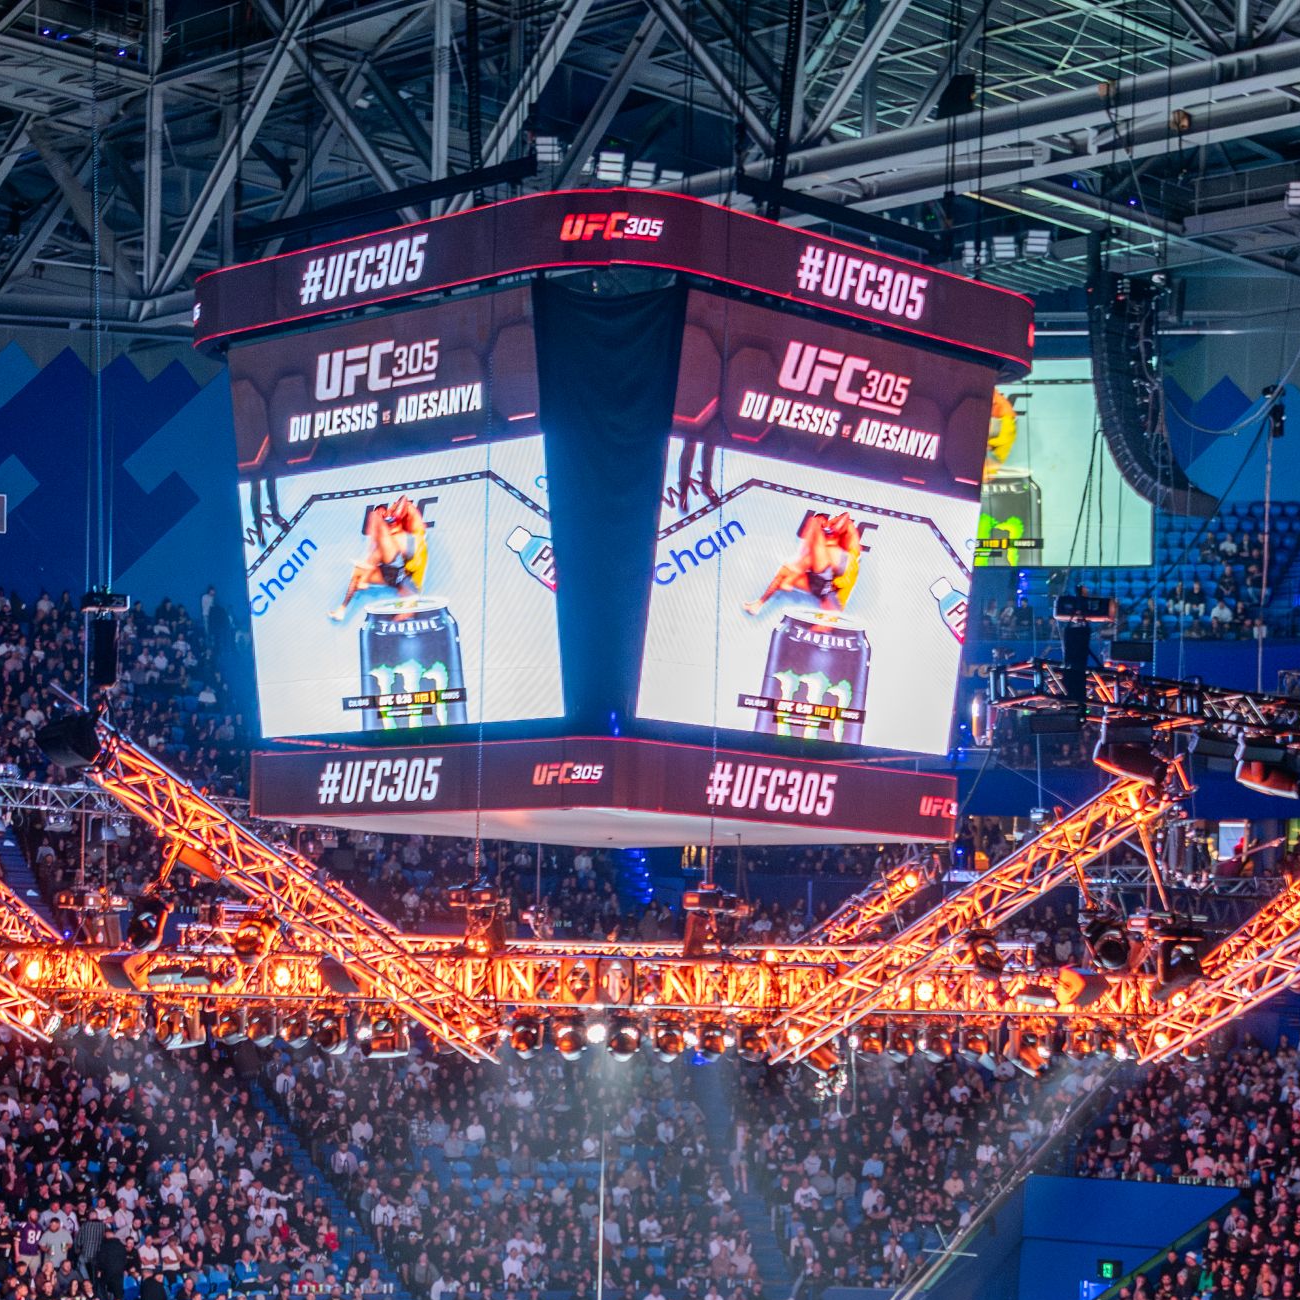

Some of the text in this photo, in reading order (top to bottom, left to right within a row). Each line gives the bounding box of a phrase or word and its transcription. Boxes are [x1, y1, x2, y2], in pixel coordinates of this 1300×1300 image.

[300, 233, 428, 304] #UFC305
[797, 246, 928, 320] #UFC305
[288, 413, 311, 442] DU
[314, 402, 378, 437] PLESSIS
[394, 382, 482, 424] ADESANYA
[739, 390, 770, 423] DU
[768, 396, 840, 437] PLESSIS
[853, 418, 940, 461] ADESANYA
[318, 757, 442, 804] #UFC305
[706, 761, 838, 817] #UFC305
